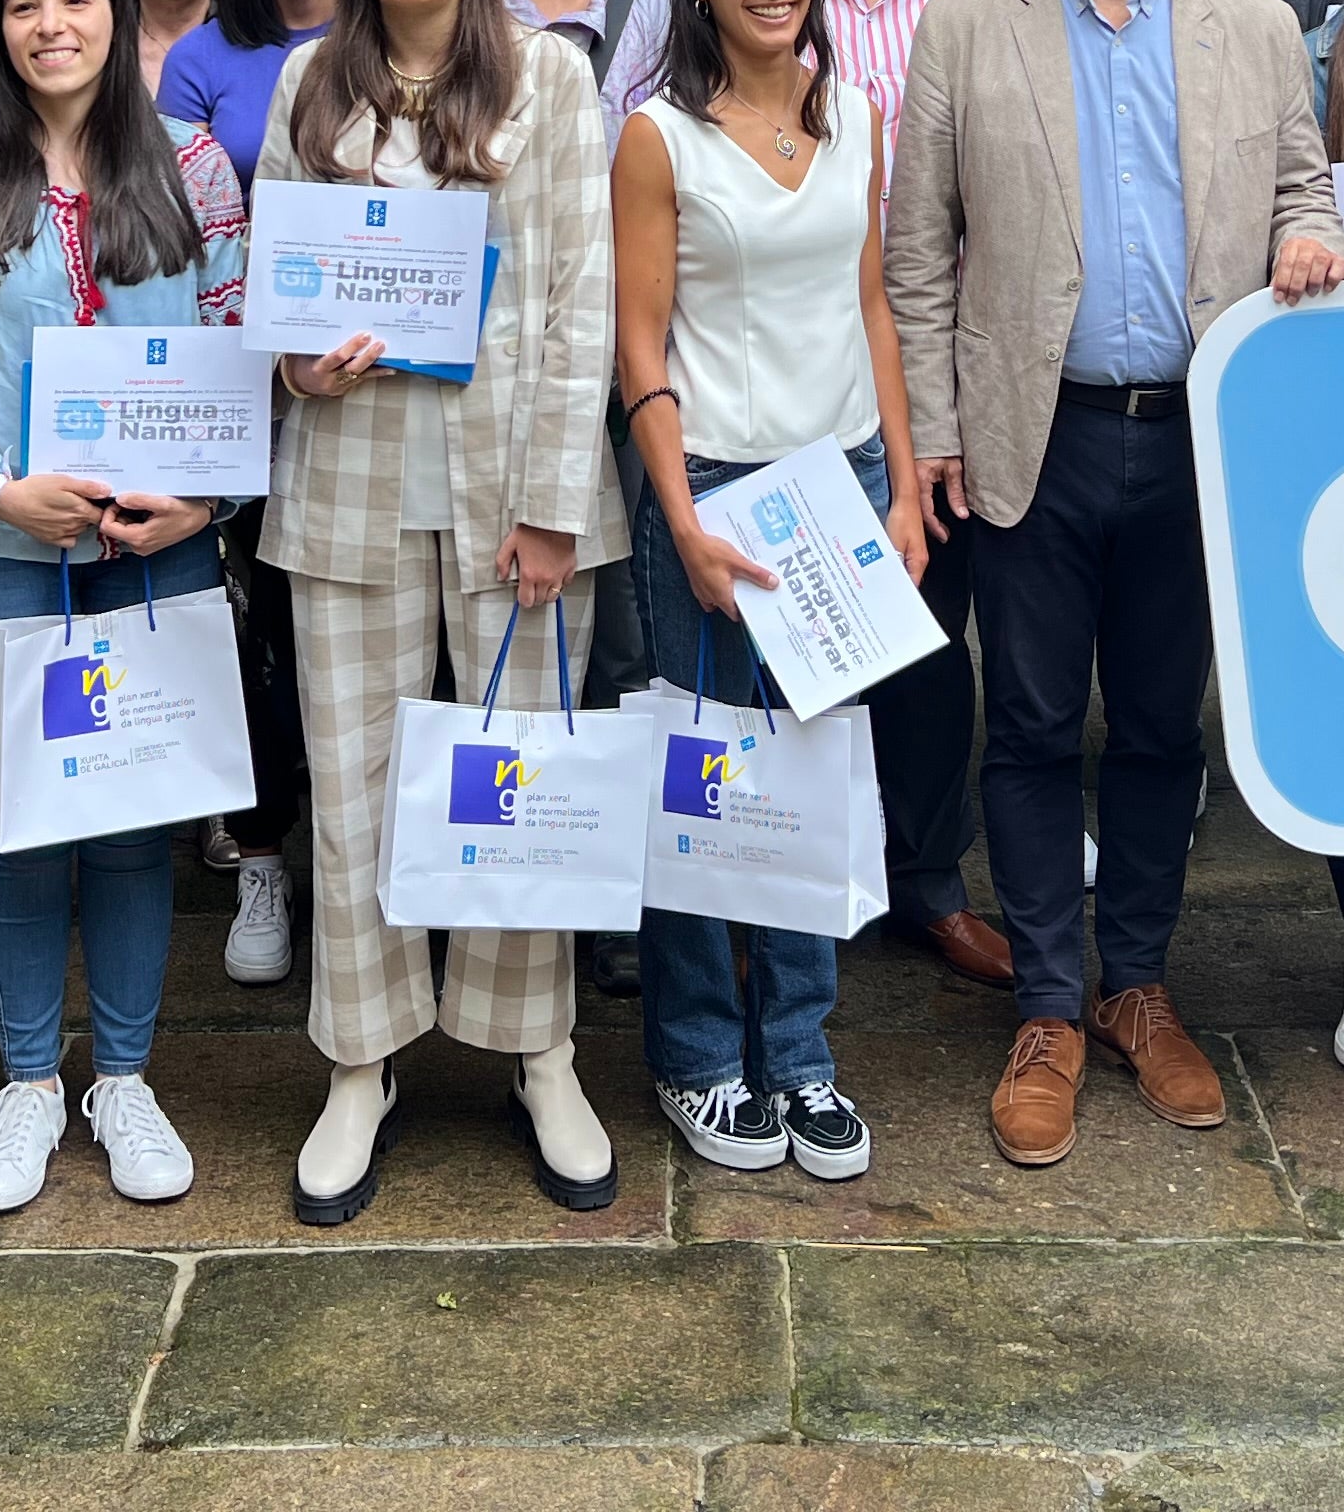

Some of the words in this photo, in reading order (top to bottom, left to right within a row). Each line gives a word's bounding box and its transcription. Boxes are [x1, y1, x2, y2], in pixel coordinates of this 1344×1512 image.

[336, 260, 434, 286] Lingua
[438, 272, 462, 286] de
[120, 398, 218, 424] Lingua
[223, 405, 249, 419] de
[794, 544, 851, 640] Lingua
[117, 694, 138, 705] plan
[140, 688, 162, 700] xeral
[119, 707, 131, 717] de
[132, 697, 195, 714] normalización
[121, 719, 132, 729] da
[134, 714, 163, 727] lingua
[165, 710, 196, 723] galega
[80, 753, 110, 765] XUNTA
[80, 764, 92, 774] DE
[94, 758, 129, 771] GALICIA
[526, 792, 546, 803] plan
[548, 793, 571, 803] xeral
[729, 789, 748, 800] plan
[749, 792, 771, 802] xeral
[525, 806, 537, 816] de
[538, 807, 600, 817] normalización
[729, 803, 740, 812] de
[741, 804, 801, 819] normalización
[524, 818, 536, 827] da
[538, 818, 567, 830] lingua
[568, 819, 599, 831] galega
[730, 814, 741, 824] da
[743, 815, 769, 829] lingua
[770, 819, 801, 832] galega
[692, 838, 718, 848] XUNTA
[478, 847, 508, 855] XUNTA
[691, 846, 702, 855] DE
[703, 847, 736, 859] GALICIA
[477, 856, 488, 864] DE
[494, 856, 526, 864] GALICIA
